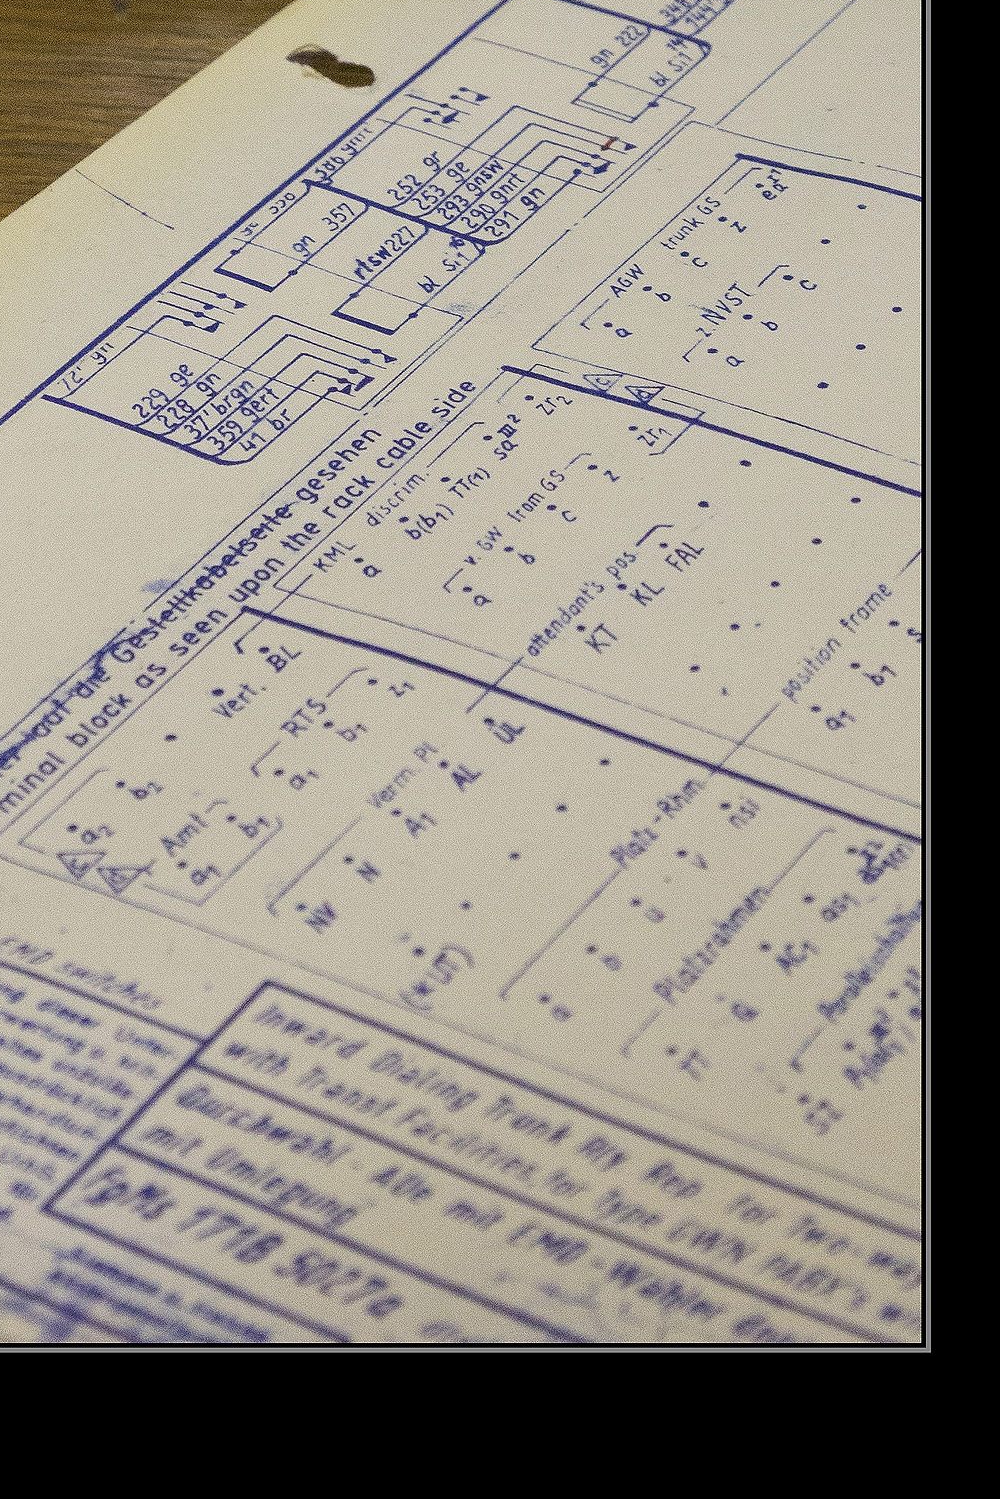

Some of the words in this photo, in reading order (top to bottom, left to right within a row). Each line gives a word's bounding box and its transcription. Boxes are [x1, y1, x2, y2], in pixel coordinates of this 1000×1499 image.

[387, 174, 422, 201] 252
[422, 151, 454, 172] gr
[410, 184, 445, 210] 253
[446, 161, 469, 183] ge
[321, 202, 355, 231] 357
[432, 194, 469, 219] 293
[460, 203, 495, 228] 290
[489, 173, 523, 203] gnrt
[483, 210, 518, 237] 291
[520, 187, 555, 211] gn
[610, 263, 643, 297] AGW
[660, 217, 703, 250] trunk
[696, 196, 721, 215] GS
[701, 282, 749, 325] NVST
[132, 388, 169, 418] 229
[169, 363, 193, 387] ge
[156, 398, 194, 428] 228
[195, 373, 220, 396] gn
[206, 420, 244, 449] 359
[238, 431, 265, 451] 41
[266, 408, 290, 431] br
[296, 429, 380, 503] gesehen
[539, 469, 565, 491] GS
[313, 541, 354, 571] KML
[366, 473, 430, 526] discrim.
[66, 693, 130, 747] block
[134, 663, 166, 688] as
[169, 609, 226, 655] seen
[229, 557, 284, 602] upon
[281, 522, 319, 551] the
[322, 475, 374, 518] rack
[376, 421, 431, 468] cable
[431, 381, 475, 419] side
[664, 542, 703, 571] FAL
[630, 581, 664, 606] KL
[584, 622, 617, 652] KT
[265, 646, 301, 672] BL
[280, 698, 326, 736] RTS
